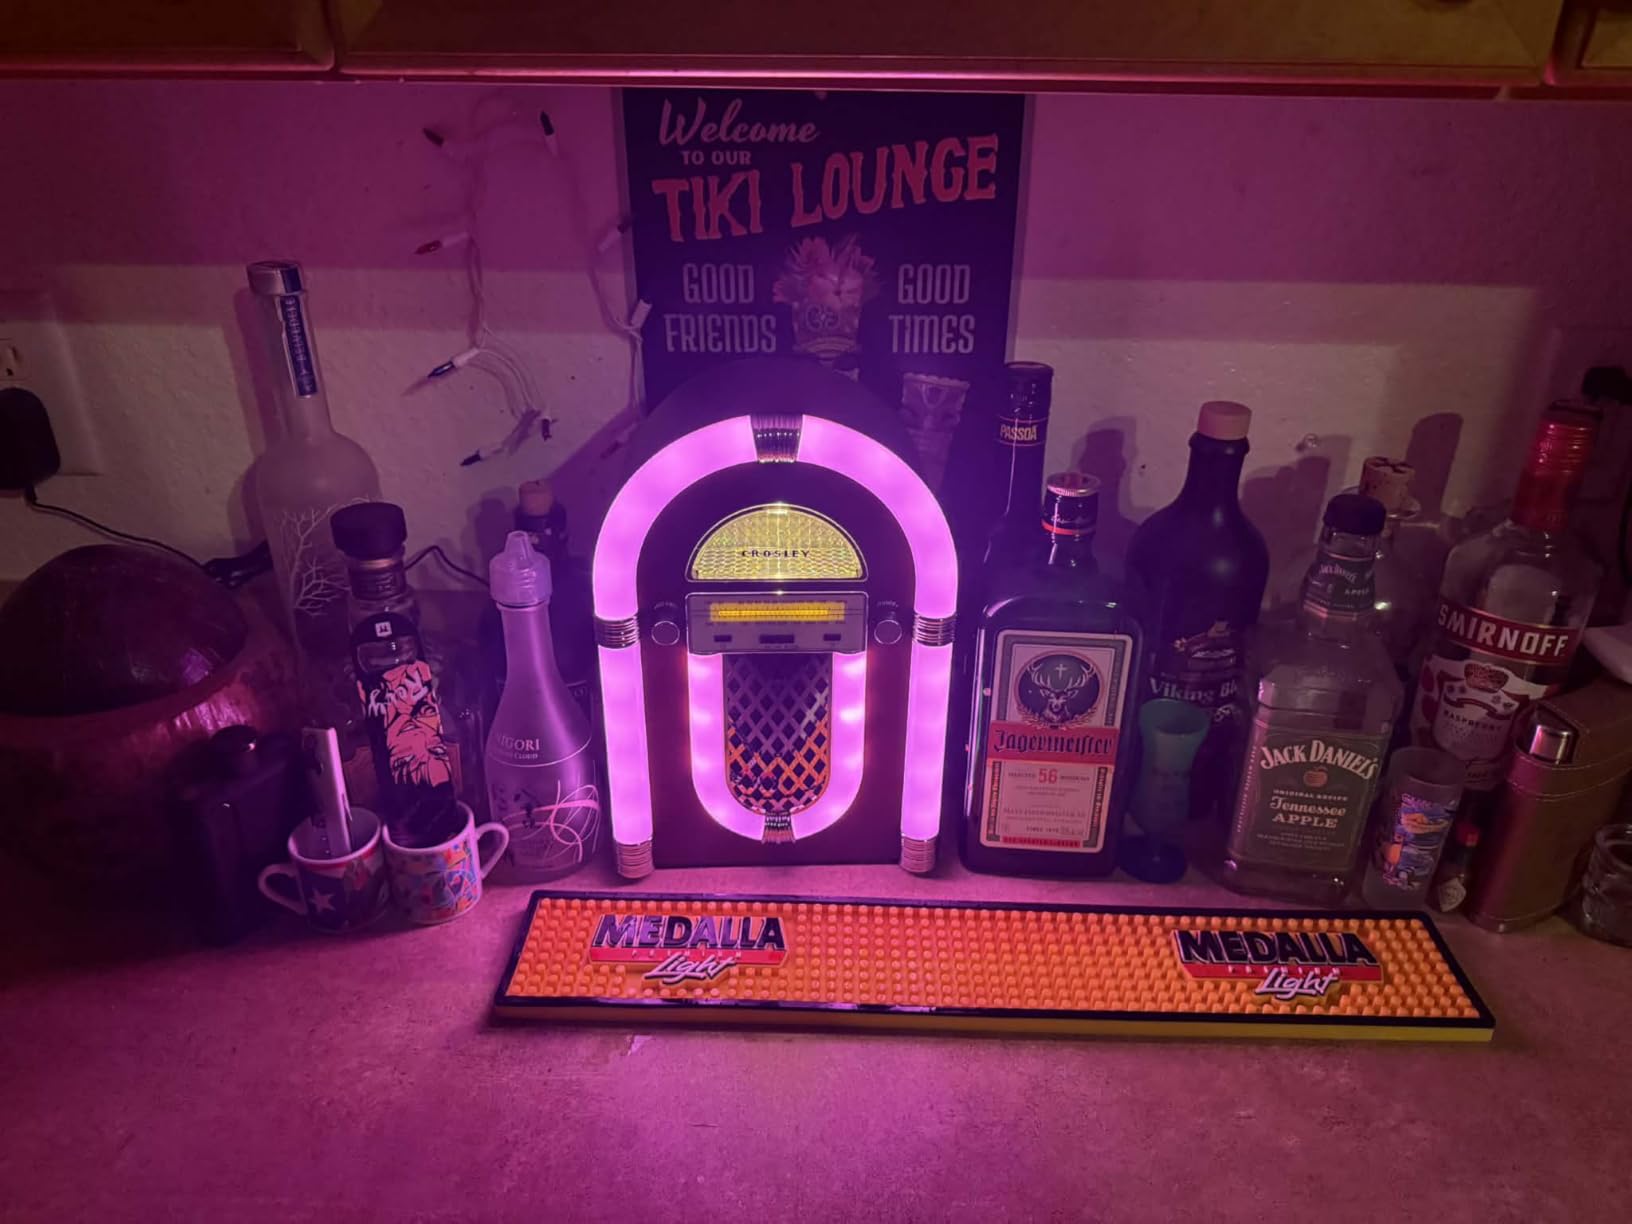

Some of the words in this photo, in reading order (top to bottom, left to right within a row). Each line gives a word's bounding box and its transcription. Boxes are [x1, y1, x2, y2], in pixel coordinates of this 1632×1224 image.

[657, 97, 821, 147] Welcome
[681, 150, 704, 166] TO
[711, 150, 752, 166] OUR
[651, 169, 764, 242] TIKI
[789, 133, 999, 228] LOUNGE
[682, 263, 755, 304] GOOD
[897, 264, 971, 304] GOOD
[663, 313, 776, 353] FRIENDS
[888, 314, 975, 355] TIMES
[741, 550, 810, 558] CROSLEY
[1438, 602, 1569, 658] SMIRNOFF
[1149, 676, 1214, 704] Viking
[1038, 768, 1058, 784] 56
[1260, 745, 1306, 769] JACK
[1309, 740, 1379, 780] DANIEL'S
[1269, 795, 1347, 816] Tennessee
[1272, 813, 1339, 829] APPLE
[592, 914, 786, 950] MEDALLA
[1172, 929, 1380, 966] MEDALLA
[644, 952, 737, 985] Light
[1255, 967, 1341, 1000] Light
